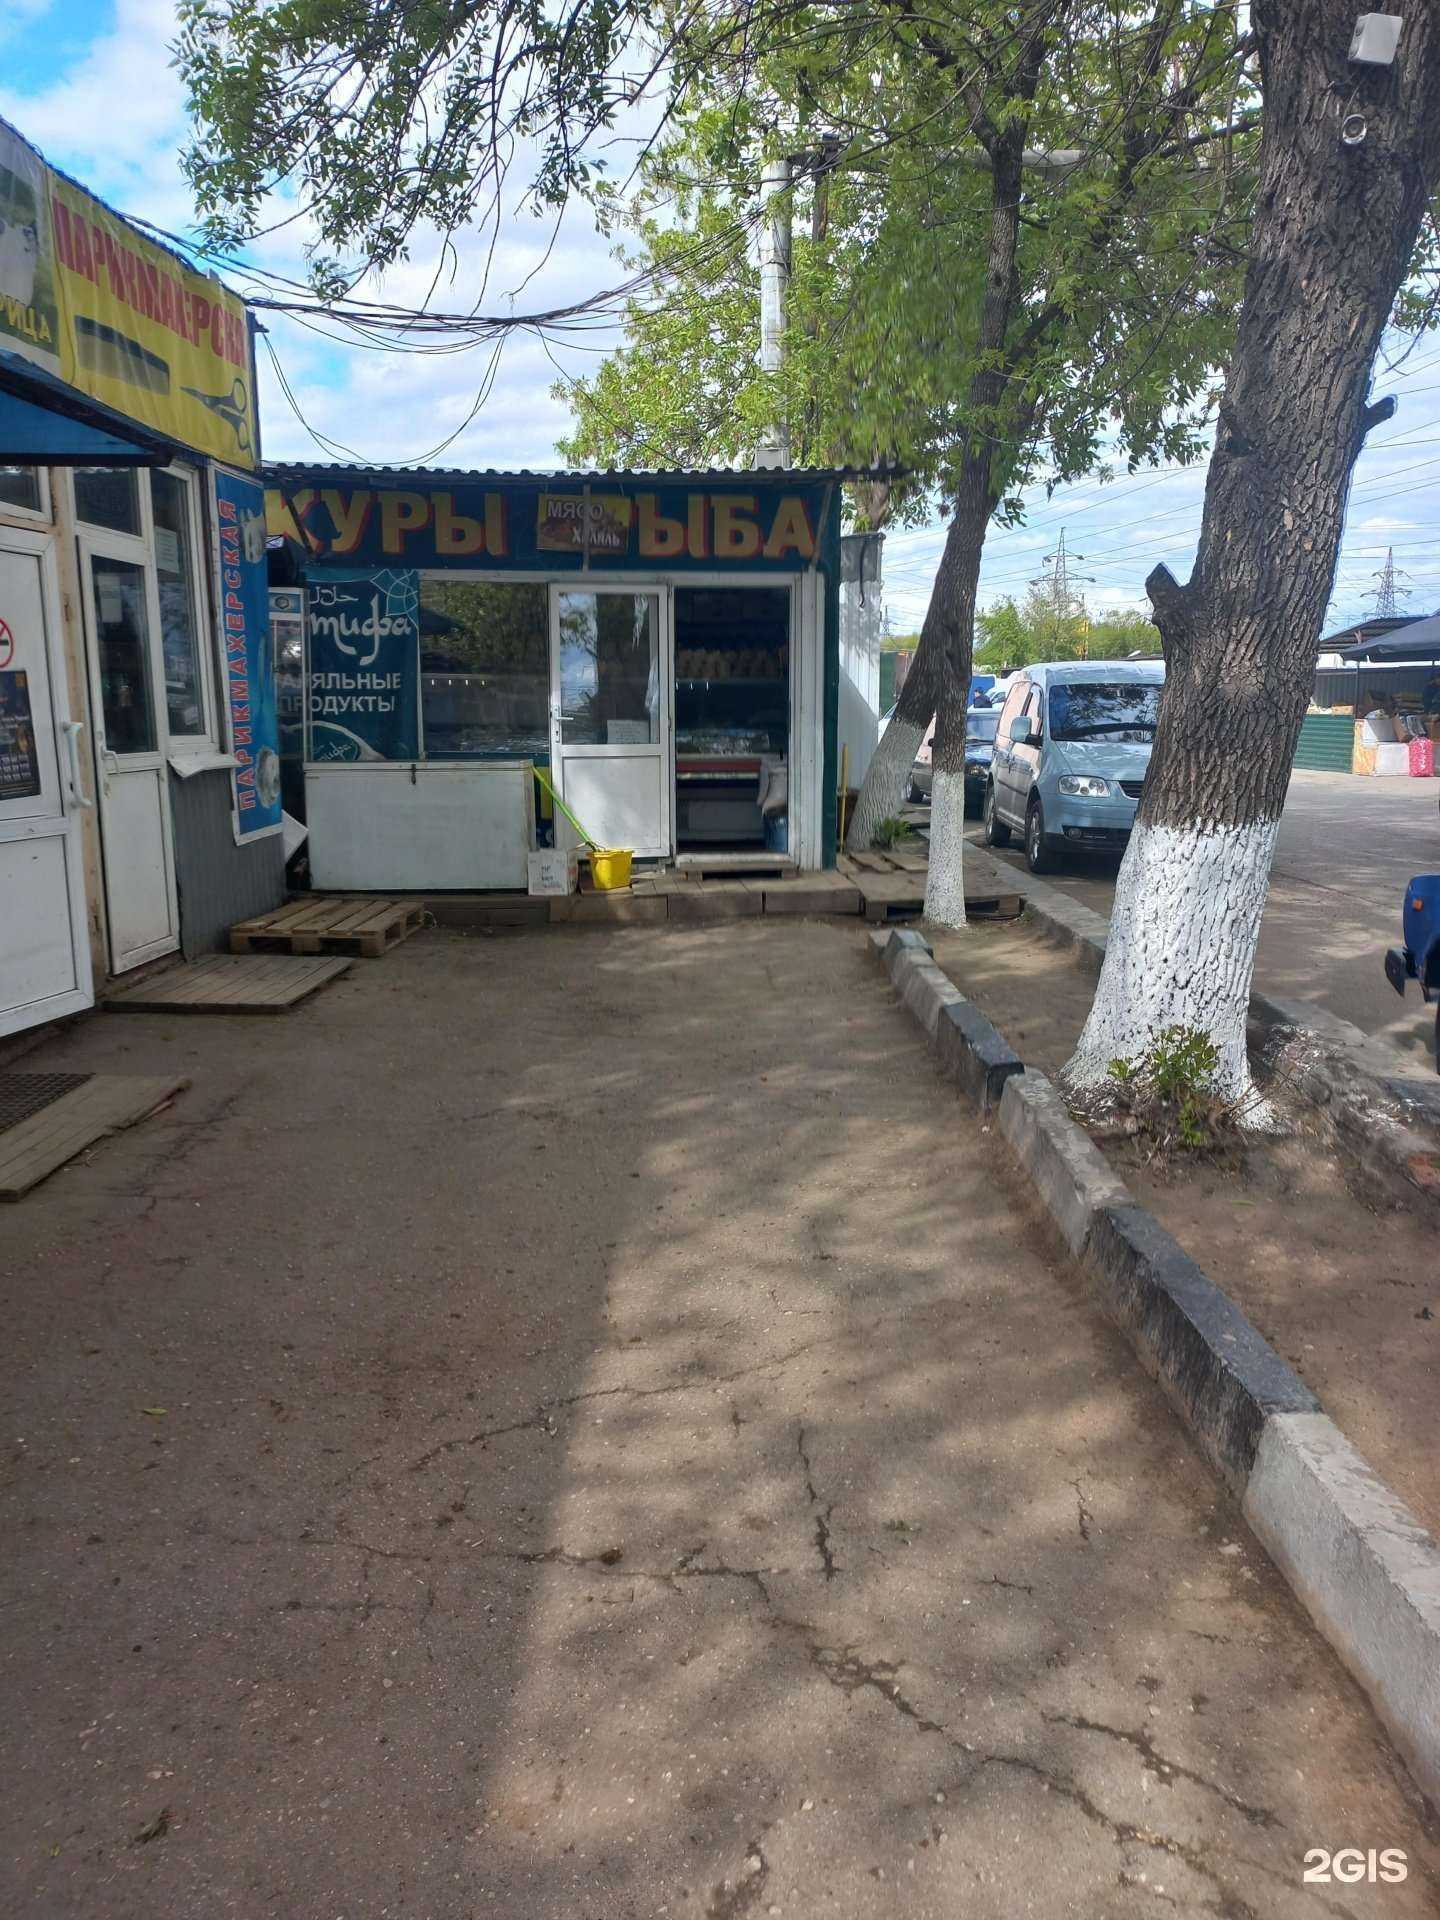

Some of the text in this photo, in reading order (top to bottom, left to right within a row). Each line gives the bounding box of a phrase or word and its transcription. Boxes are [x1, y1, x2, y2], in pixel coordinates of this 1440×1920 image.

[0, 294, 52, 343] ИЦА
[264, 488, 820, 559] КУРЫ ЫБА
[547, 500, 603, 521] МЯСО
[218, 498, 256, 810] ПАРИКМАХЕРСКАЯ
